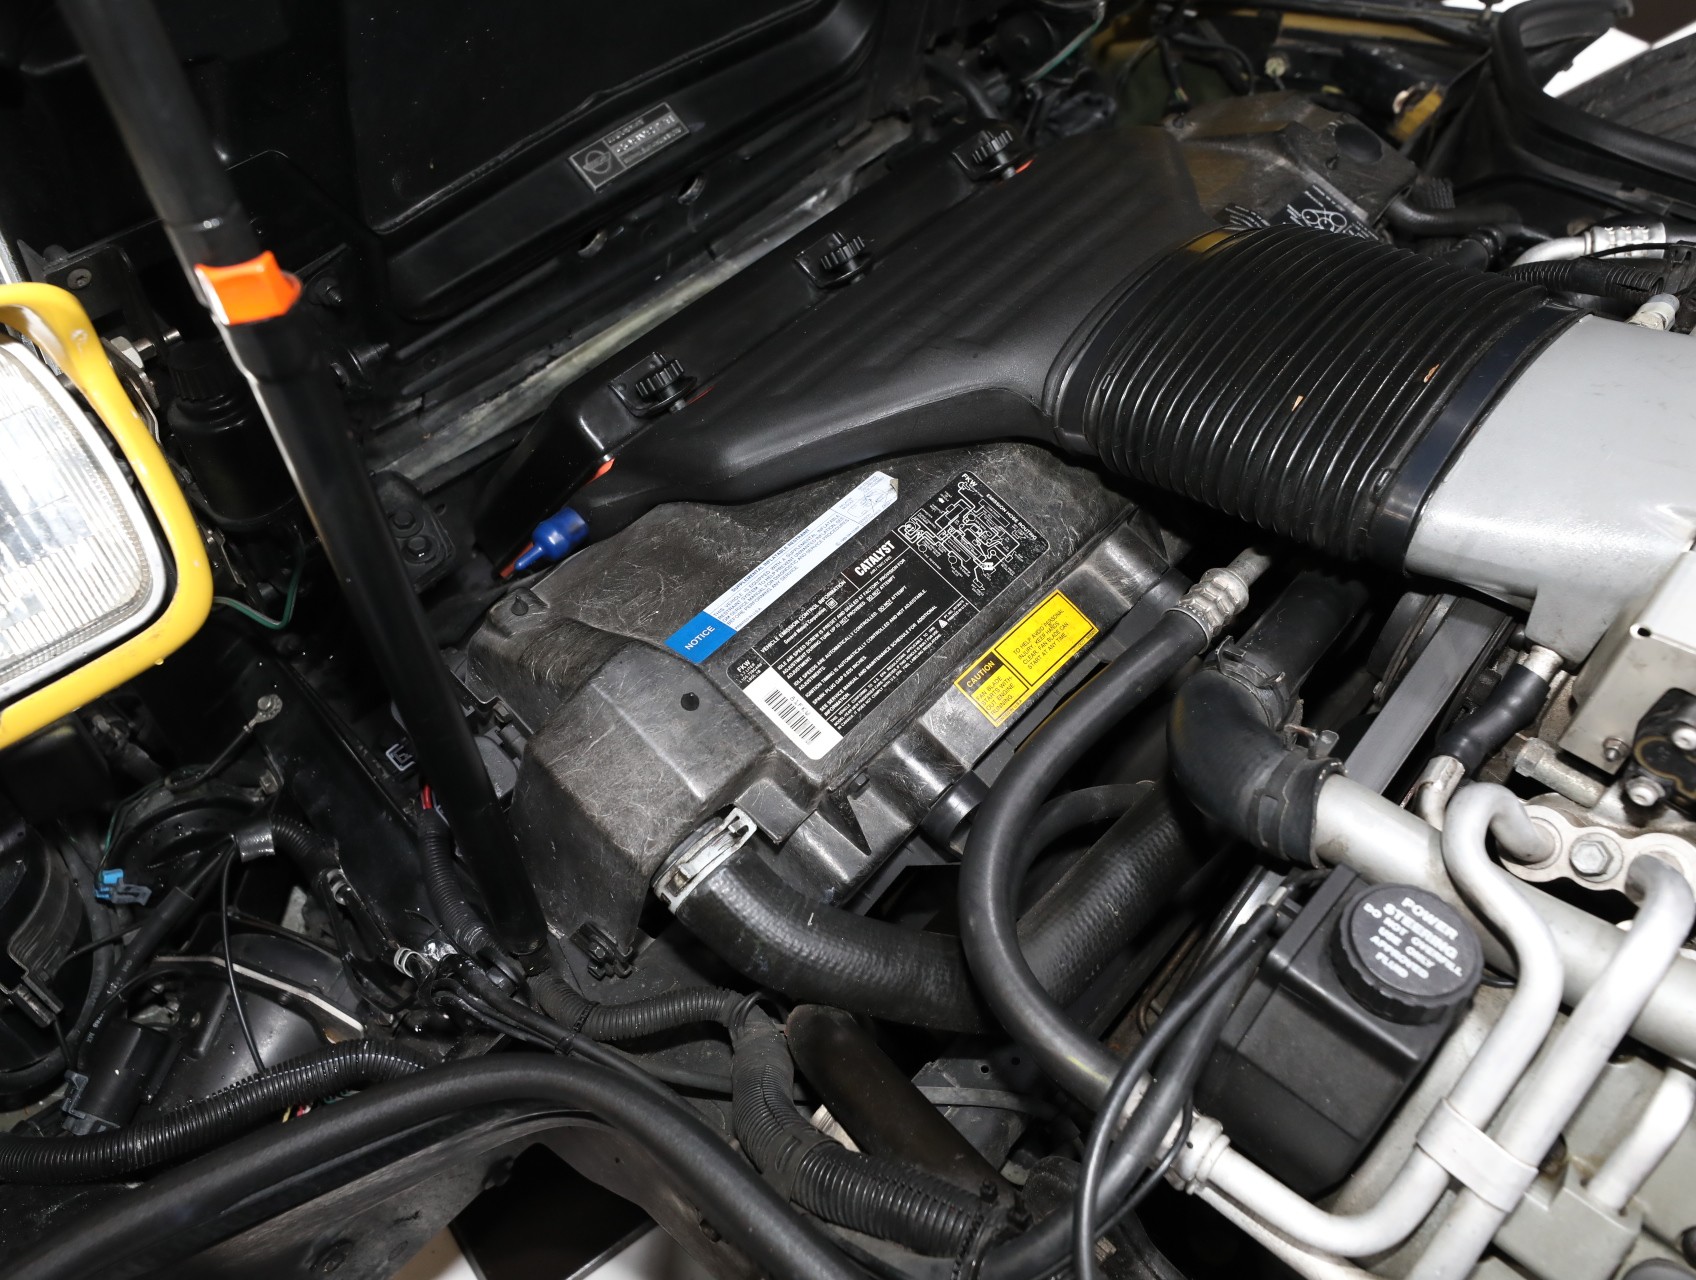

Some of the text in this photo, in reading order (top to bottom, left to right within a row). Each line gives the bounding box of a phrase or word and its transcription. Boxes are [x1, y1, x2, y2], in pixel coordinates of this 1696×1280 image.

[961, 472, 978, 487] FKW
[985, 493, 1007, 512] EMISSION
[1005, 511, 1019, 523] HOSE
[1017, 521, 1037, 540] ROUTING
[852, 539, 896, 576] CATALYST
[759, 579, 847, 653] VEHICLE EMISSION CONTROL INFORMATION
[776, 660, 787, 670] IDLE
[785, 654, 794, 662] AIR
[792, 644, 806, 656] SPEED
[804, 632, 820, 646] SCREW
[822, 617, 837, 631] PRESET
[835, 610, 845, 619] AND
[843, 598, 859, 612] SEALED
[878, 564, 898, 582] PROVISION
[896, 558, 906, 566] FOR
[781, 651, 807, 674] ADJUSTMENT
[805, 639, 821, 653] DURING
[819, 630, 831, 641] TUNE
[829, 625, 837, 633] UP
[838, 615, 848, 624] NOT
[871, 588, 880, 596] NOT
[878, 574, 896, 590] ATTEMPT
[783, 606, 827, 644] General Motors Corporation
[1012, 608, 1064, 655] TO HELP AVOID PERSONAL
[1033, 632, 1047, 644] KEEP
[1044, 620, 1060, 634] HANDS
[684, 624, 716, 650] NOTICE
[792, 676, 803, 686] IDLE
[801, 663, 818, 678] SPEEDS
[816, 656, 826, 665] ARE
[823, 631, 855, 658] AUTOMATICALLY
[882, 598, 892, 606] NOT
[890, 585, 907, 600] ATTEMPT
[804, 681, 823, 697] IGNITION
[820, 670, 835, 683] TIMING
[836, 641, 867, 668] AUTOMATICALLY
[865, 620, 890, 643] CONTROLLED
[888, 614, 898, 623] AND
[895, 607, 905, 616] NOT
[1037, 641, 1047, 651] FAN
[1046, 629, 1060, 643] BLADE
[1059, 621, 1069, 631] CAN
[736, 659, 751, 672] FKW
[818, 703, 828, 712] SEE
[826, 688, 844, 705] SERVICE
[842, 675, 859, 690] MANUAL
[857, 667, 867, 677] AND
[865, 645, 892, 669] MAINTENANCE
[889, 629, 910, 647] SCHEDULE
[907, 622, 917, 631] FOR
[915, 604, 937, 624] ADDITIONAL
[964, 659, 996, 688] CAUTION
[1026, 654, 1042, 669] START
[1040, 649, 1048, 657] AT
[1046, 641, 1057, 651] ANY
[811, 691, 826, 705] SPARK
[824, 682, 836, 693] PLUG
[834, 674, 844, 684] GAP
[975, 675, 1002, 700] FAN BLADE
[980, 686, 1000, 705] STARTS
[985, 682, 1015, 711] OUT ENGINE
[1383, 903, 1458, 960] STEERING
[1401, 897, 1458, 940] POWER
[1363, 903, 1463, 977] DO NOT OVERFILL
[1370, 935, 1429, 979] APPROVED
[1378, 927, 1436, 968] USE ONLY
[1375, 952, 1408, 978] FLUID
